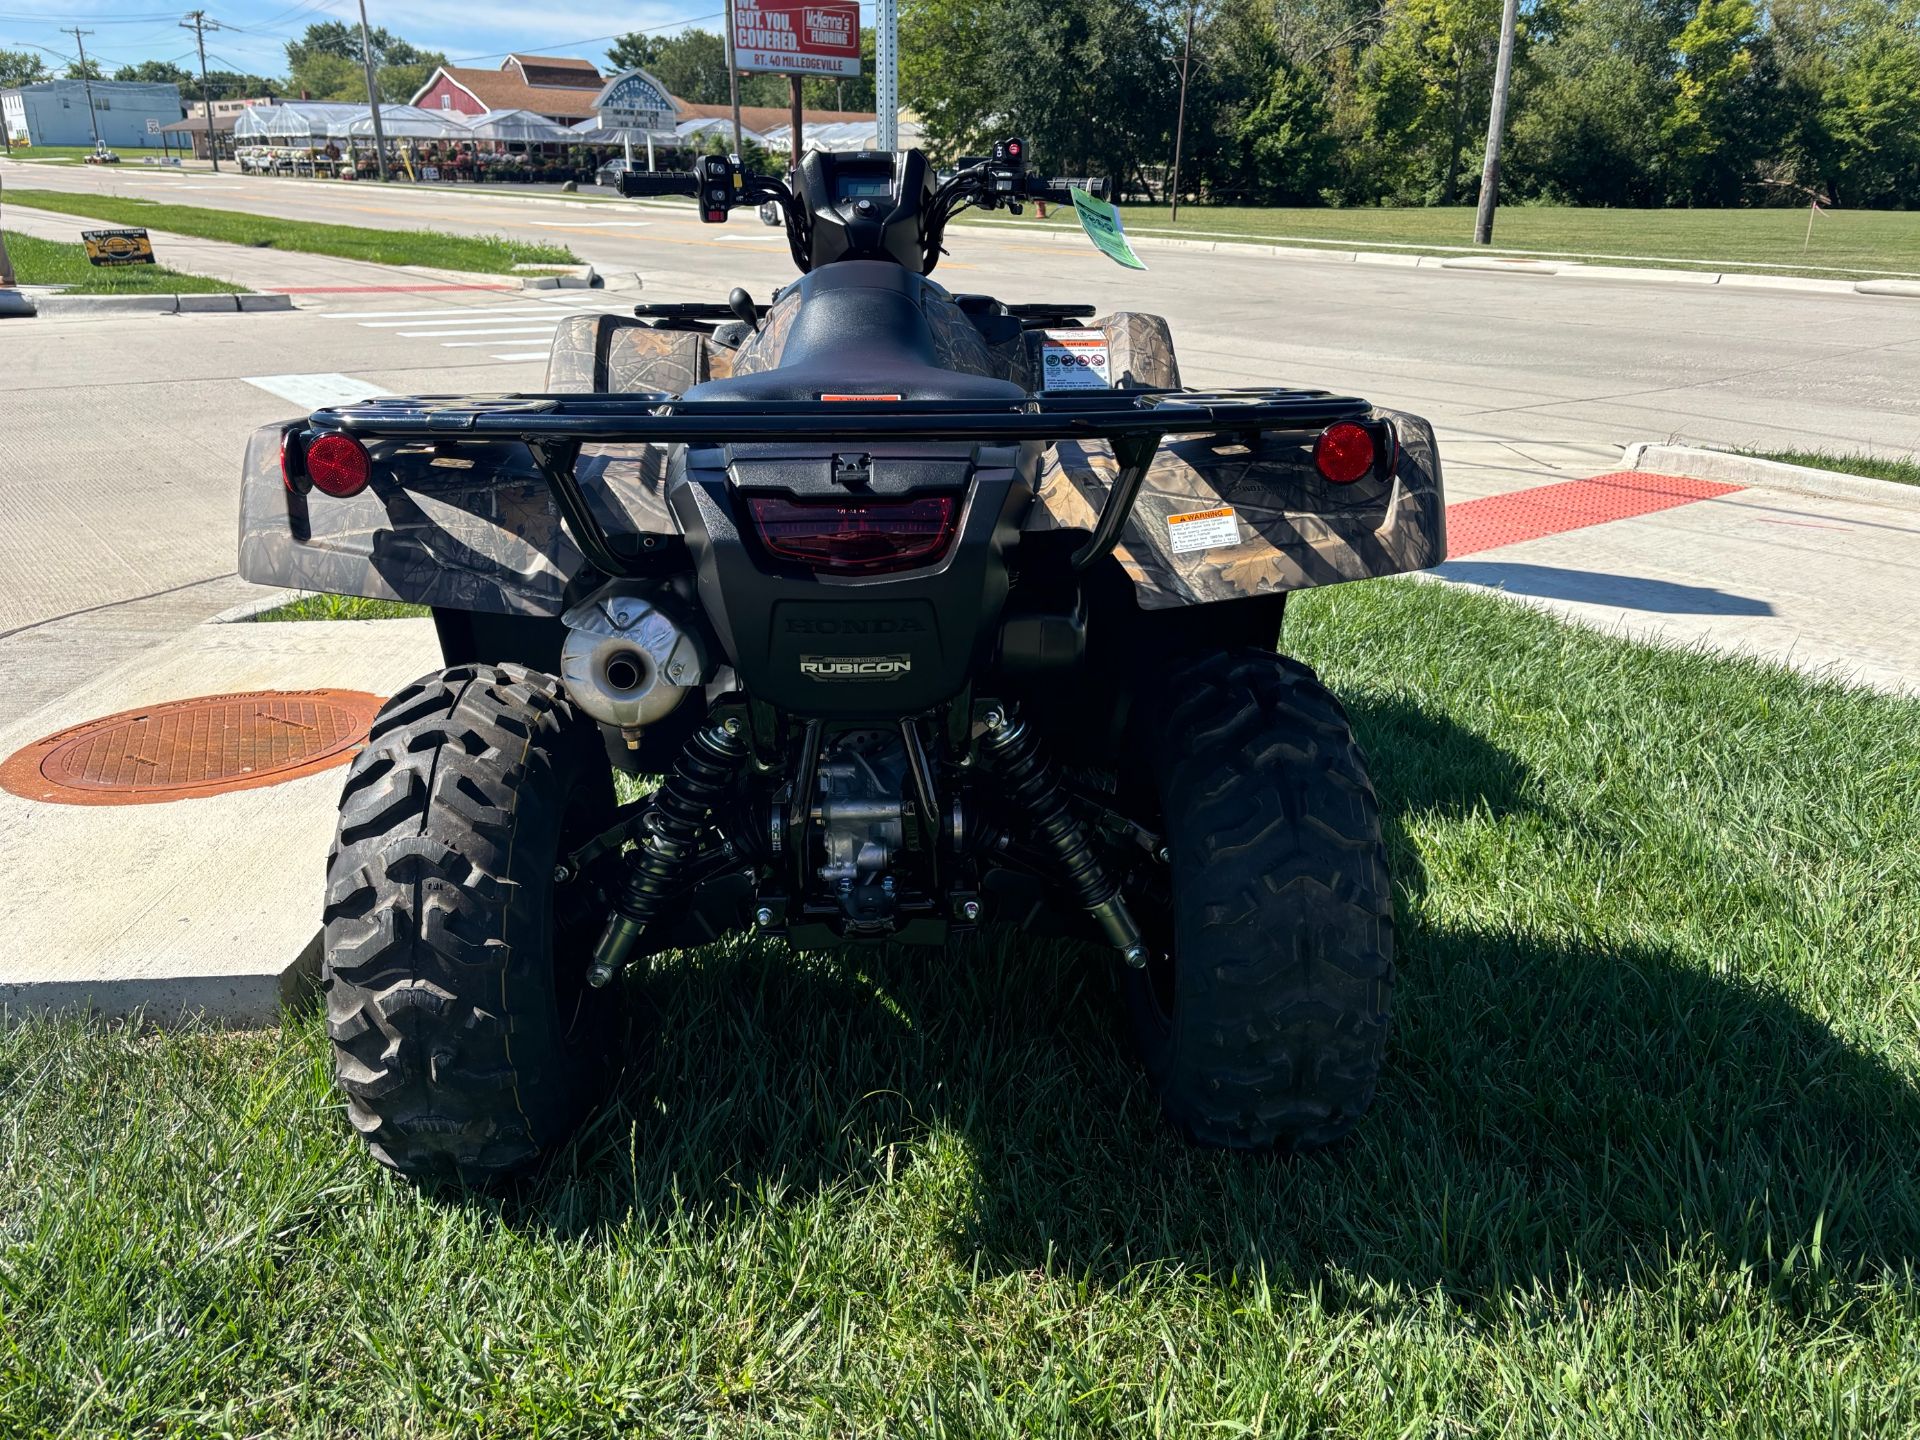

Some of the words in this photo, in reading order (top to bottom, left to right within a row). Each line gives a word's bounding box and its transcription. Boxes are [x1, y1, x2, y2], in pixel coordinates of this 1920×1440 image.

[737, 9, 764, 29] GOT.
[765, 12, 793, 31] YOU.
[805, 9, 850, 31] McKenna's
[737, 28, 801, 51] COVERED.
[811, 30, 848, 45] FLOORING
[754, 53, 768, 65] RT.
[769, 55, 781, 66] 40
[782, 56, 844, 71] MILLEDGEVILLE
[1187, 510, 1224, 521] WARNING
[785, 618, 928, 634] HONDA
[800, 660, 911, 673] RUBICON
